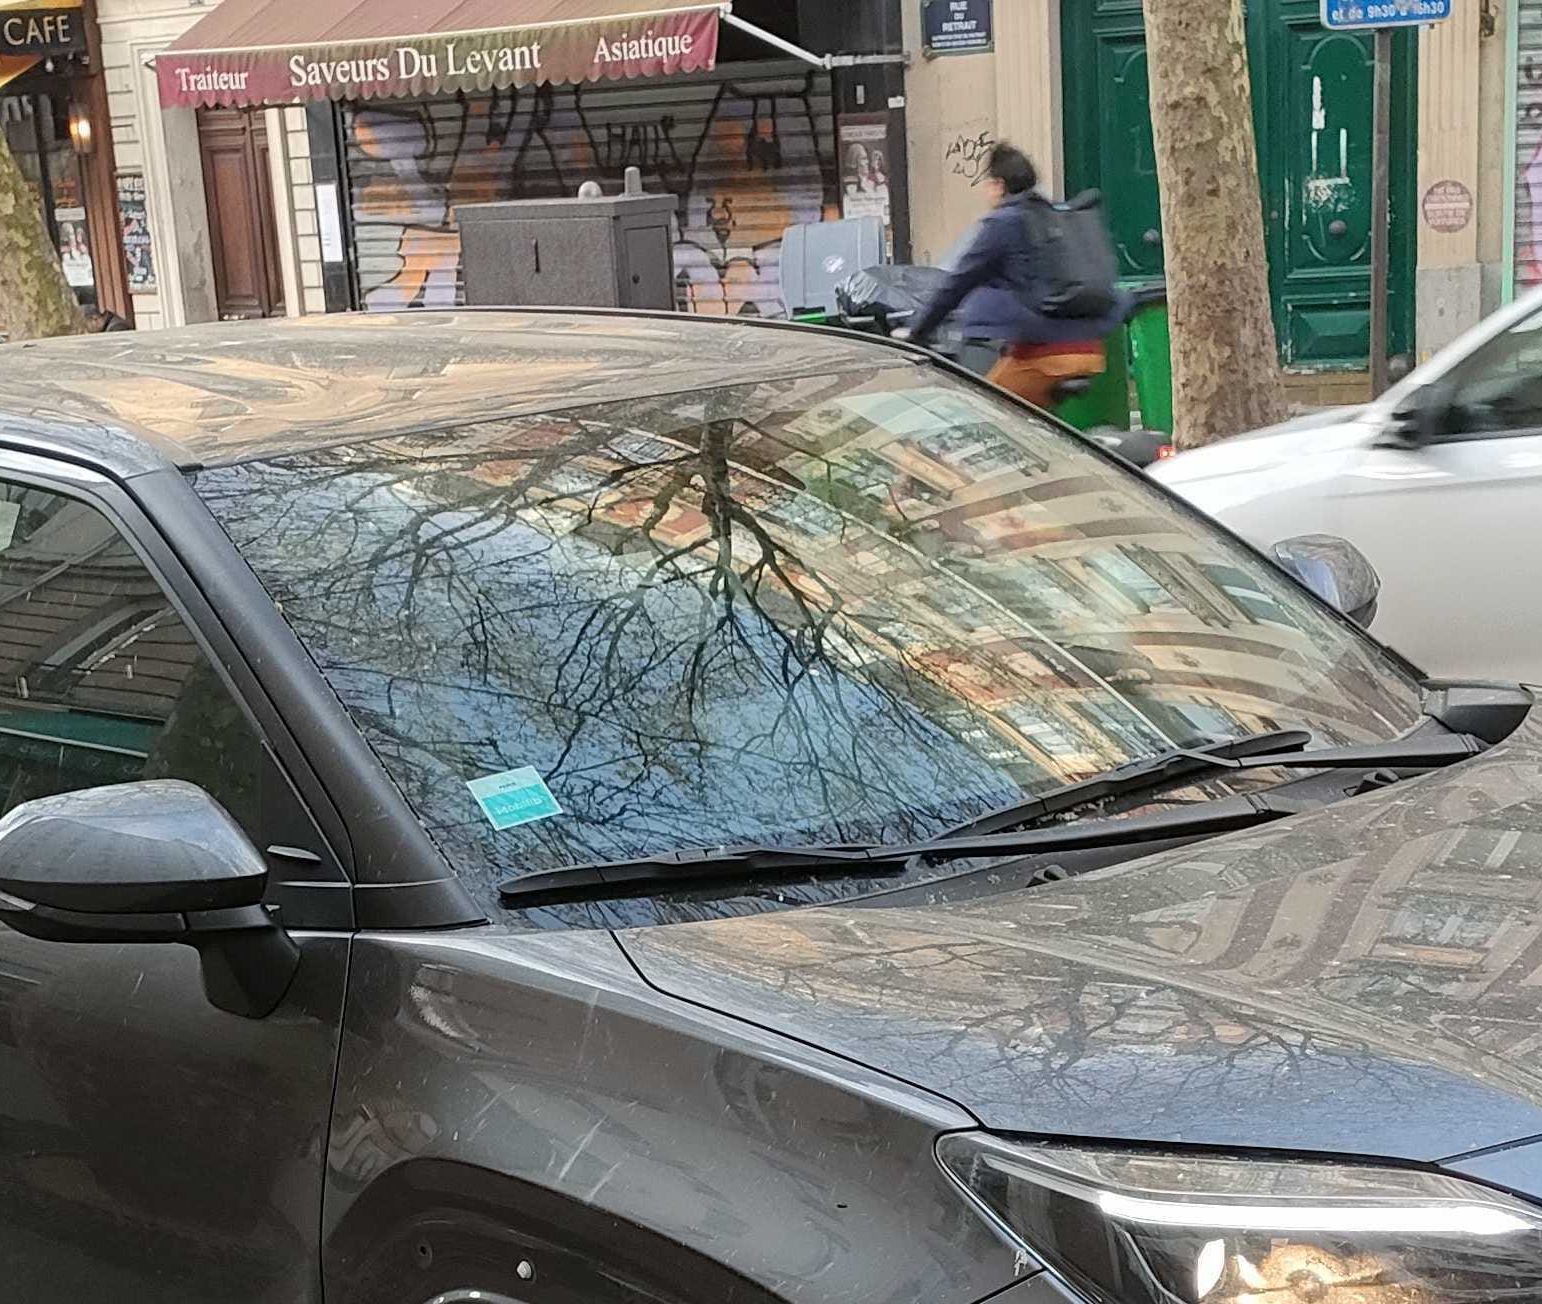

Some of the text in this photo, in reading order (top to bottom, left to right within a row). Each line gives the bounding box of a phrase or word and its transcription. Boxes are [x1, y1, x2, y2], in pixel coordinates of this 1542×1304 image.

[949, 1, 968, 12] RUE
[3, 15, 71, 46] CAFE
[175, 32, 694, 92] Traiteur Saveurs Du Levant Asiatique
